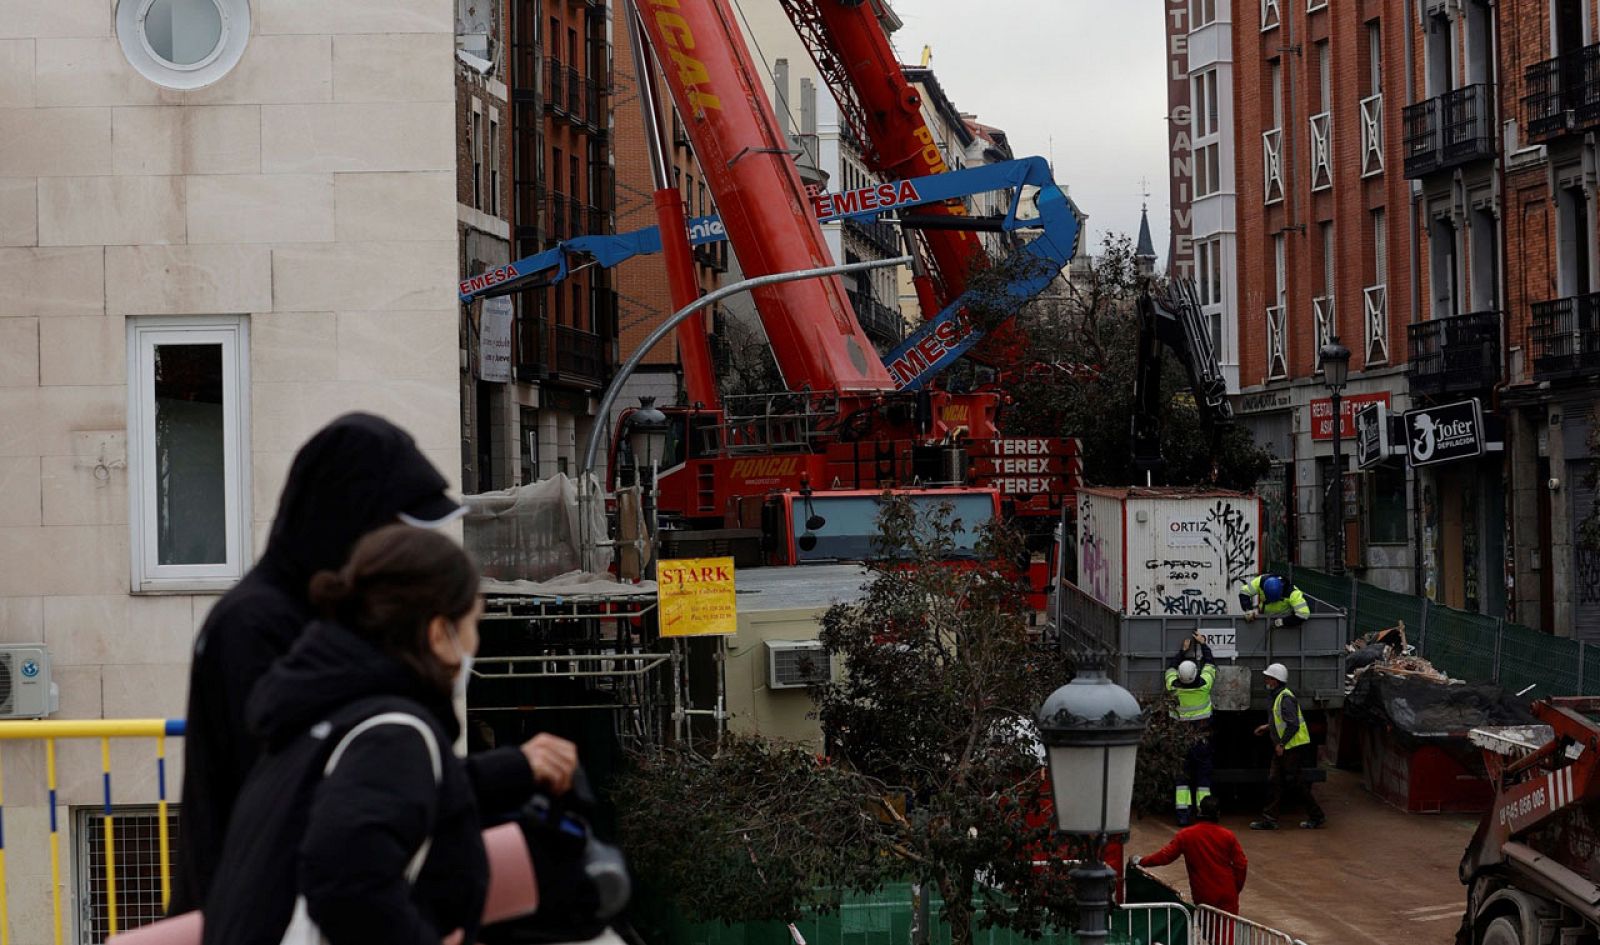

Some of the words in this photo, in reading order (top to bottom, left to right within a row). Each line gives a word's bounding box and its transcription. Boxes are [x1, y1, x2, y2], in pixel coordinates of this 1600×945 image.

[1169, 0, 1188, 80] TEL
[649, 0, 722, 117] CAL
[814, 180, 921, 219] EMESA
[1172, 105, 1194, 280] GANIVET
[690, 219, 724, 239] nie
[460, 264, 518, 294] EMESA
[943, 404, 970, 421] NCAL
[1312, 400, 1350, 417] RESTAUNTE
[1437, 419, 1473, 442] Jofer
[990, 439, 1049, 455] TEREX
[729, 458, 799, 479] PONCAL
[991, 458, 1049, 473] TEREX
[992, 477, 1050, 493] TEREX
[1170, 521, 1209, 532] ORTIZ
[663, 566, 731, 585] STARK
[1201, 634, 1236, 645] RTIZ
